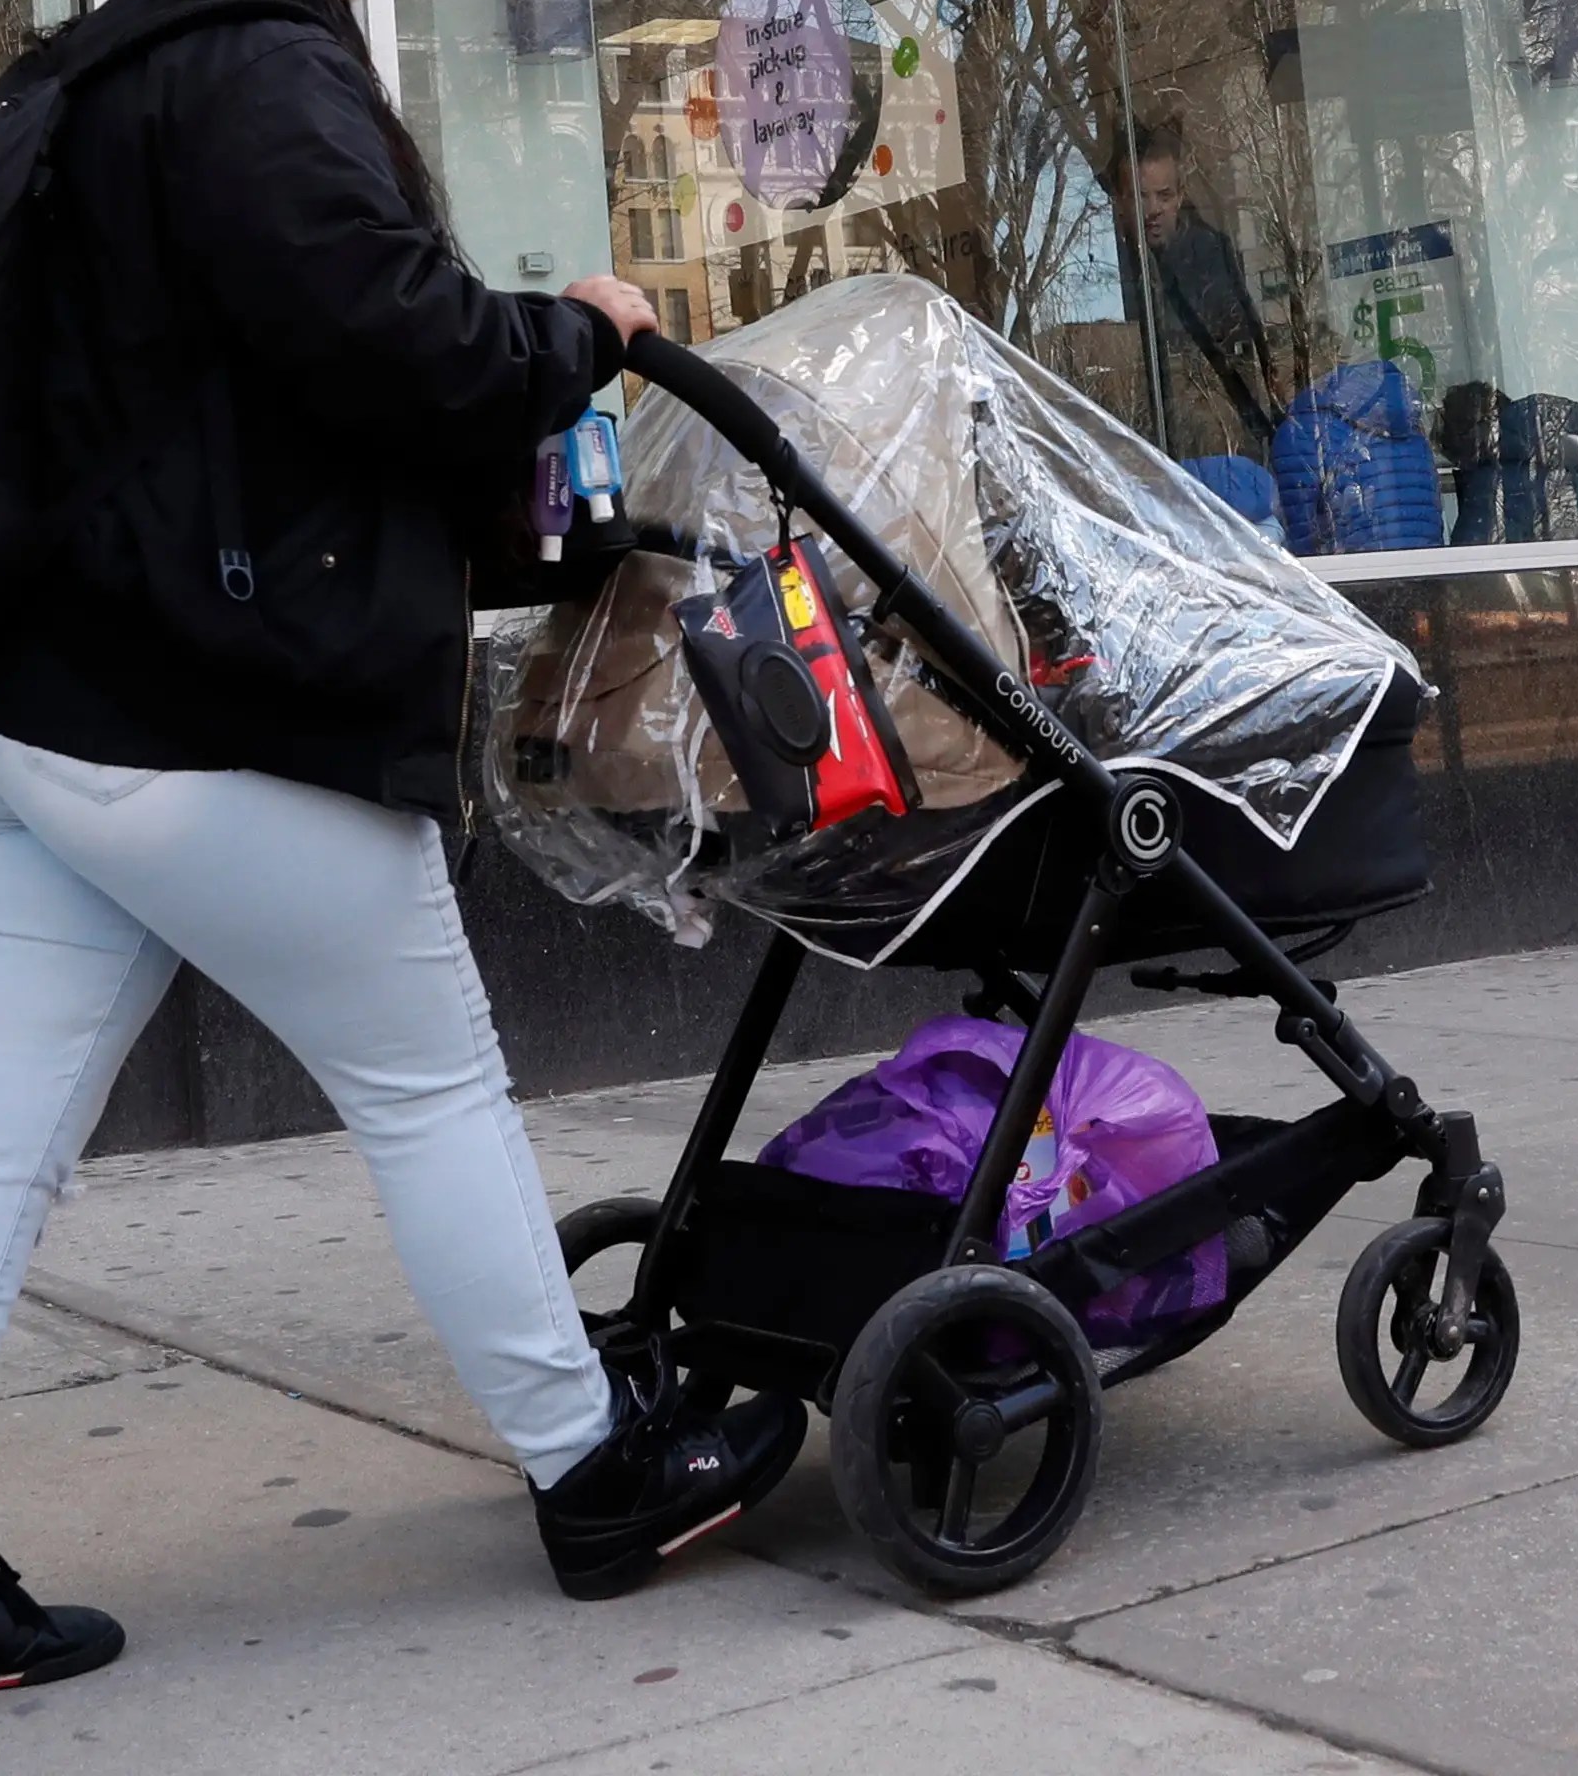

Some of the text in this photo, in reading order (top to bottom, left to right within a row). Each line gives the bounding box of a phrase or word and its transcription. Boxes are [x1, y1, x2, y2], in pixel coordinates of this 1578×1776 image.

[748, 44, 807, 89] pick-up
[775, 81, 790, 106] &
[753, 108, 816, 145] layaway
[1373, 271, 1420, 294] earn
[1352, 293, 1437, 404] $5
[996, 671, 1084, 765] Contours
[685, 1455, 720, 1472] FILA
